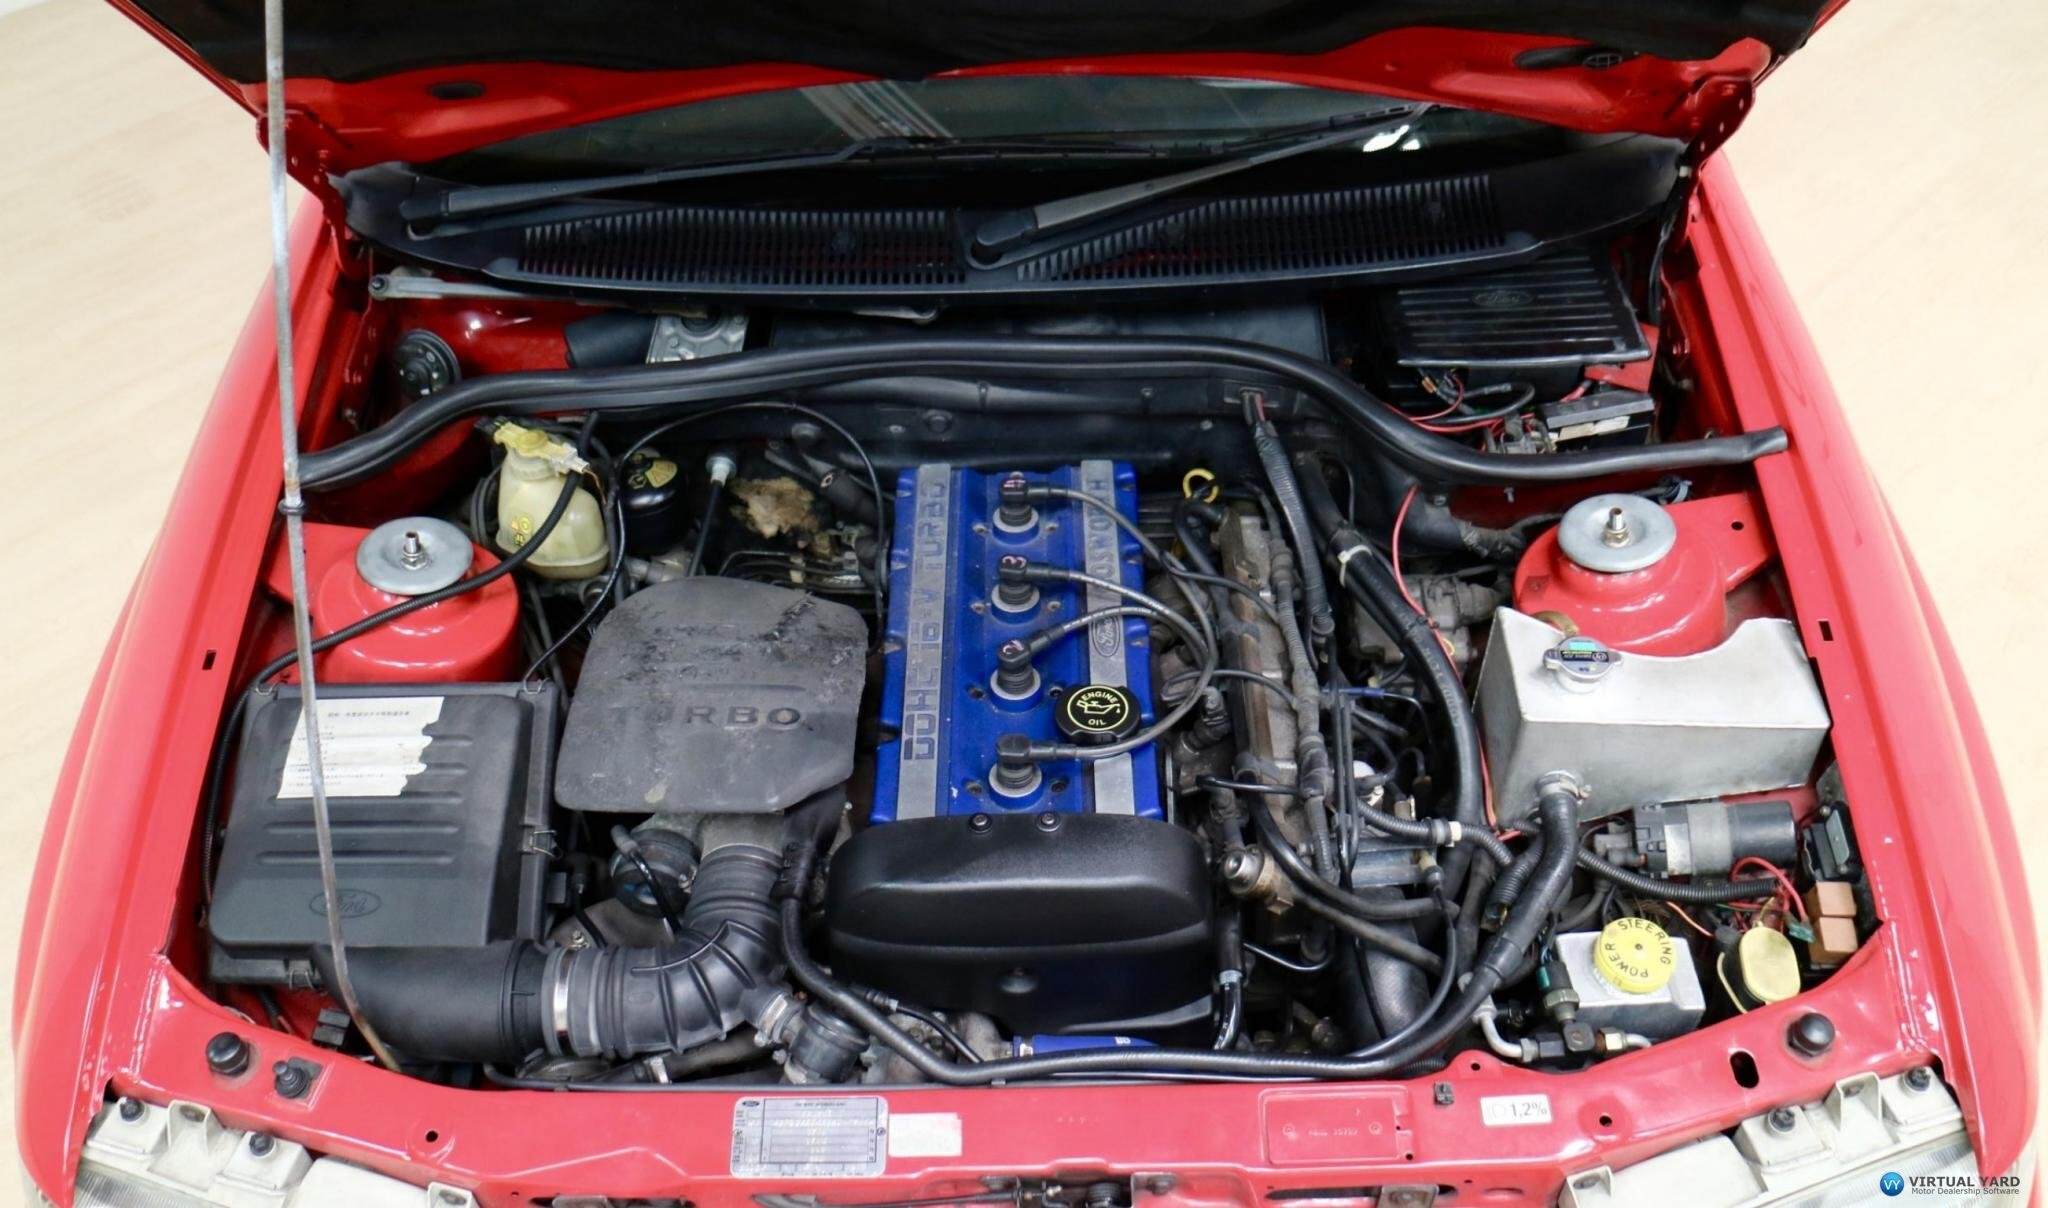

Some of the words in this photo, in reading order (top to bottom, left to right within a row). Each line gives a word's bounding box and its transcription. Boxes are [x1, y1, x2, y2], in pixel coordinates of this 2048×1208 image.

[916, 482, 945, 574] TURBO
[1087, 479, 1118, 593] OSWORH
[904, 668, 938, 760] DOHC
[1081, 691, 1119, 703] ENGINE
[1088, 718, 1107, 726] OIL
[1604, 942, 1649, 978] POWER
[1617, 918, 1672, 965] STEERING
